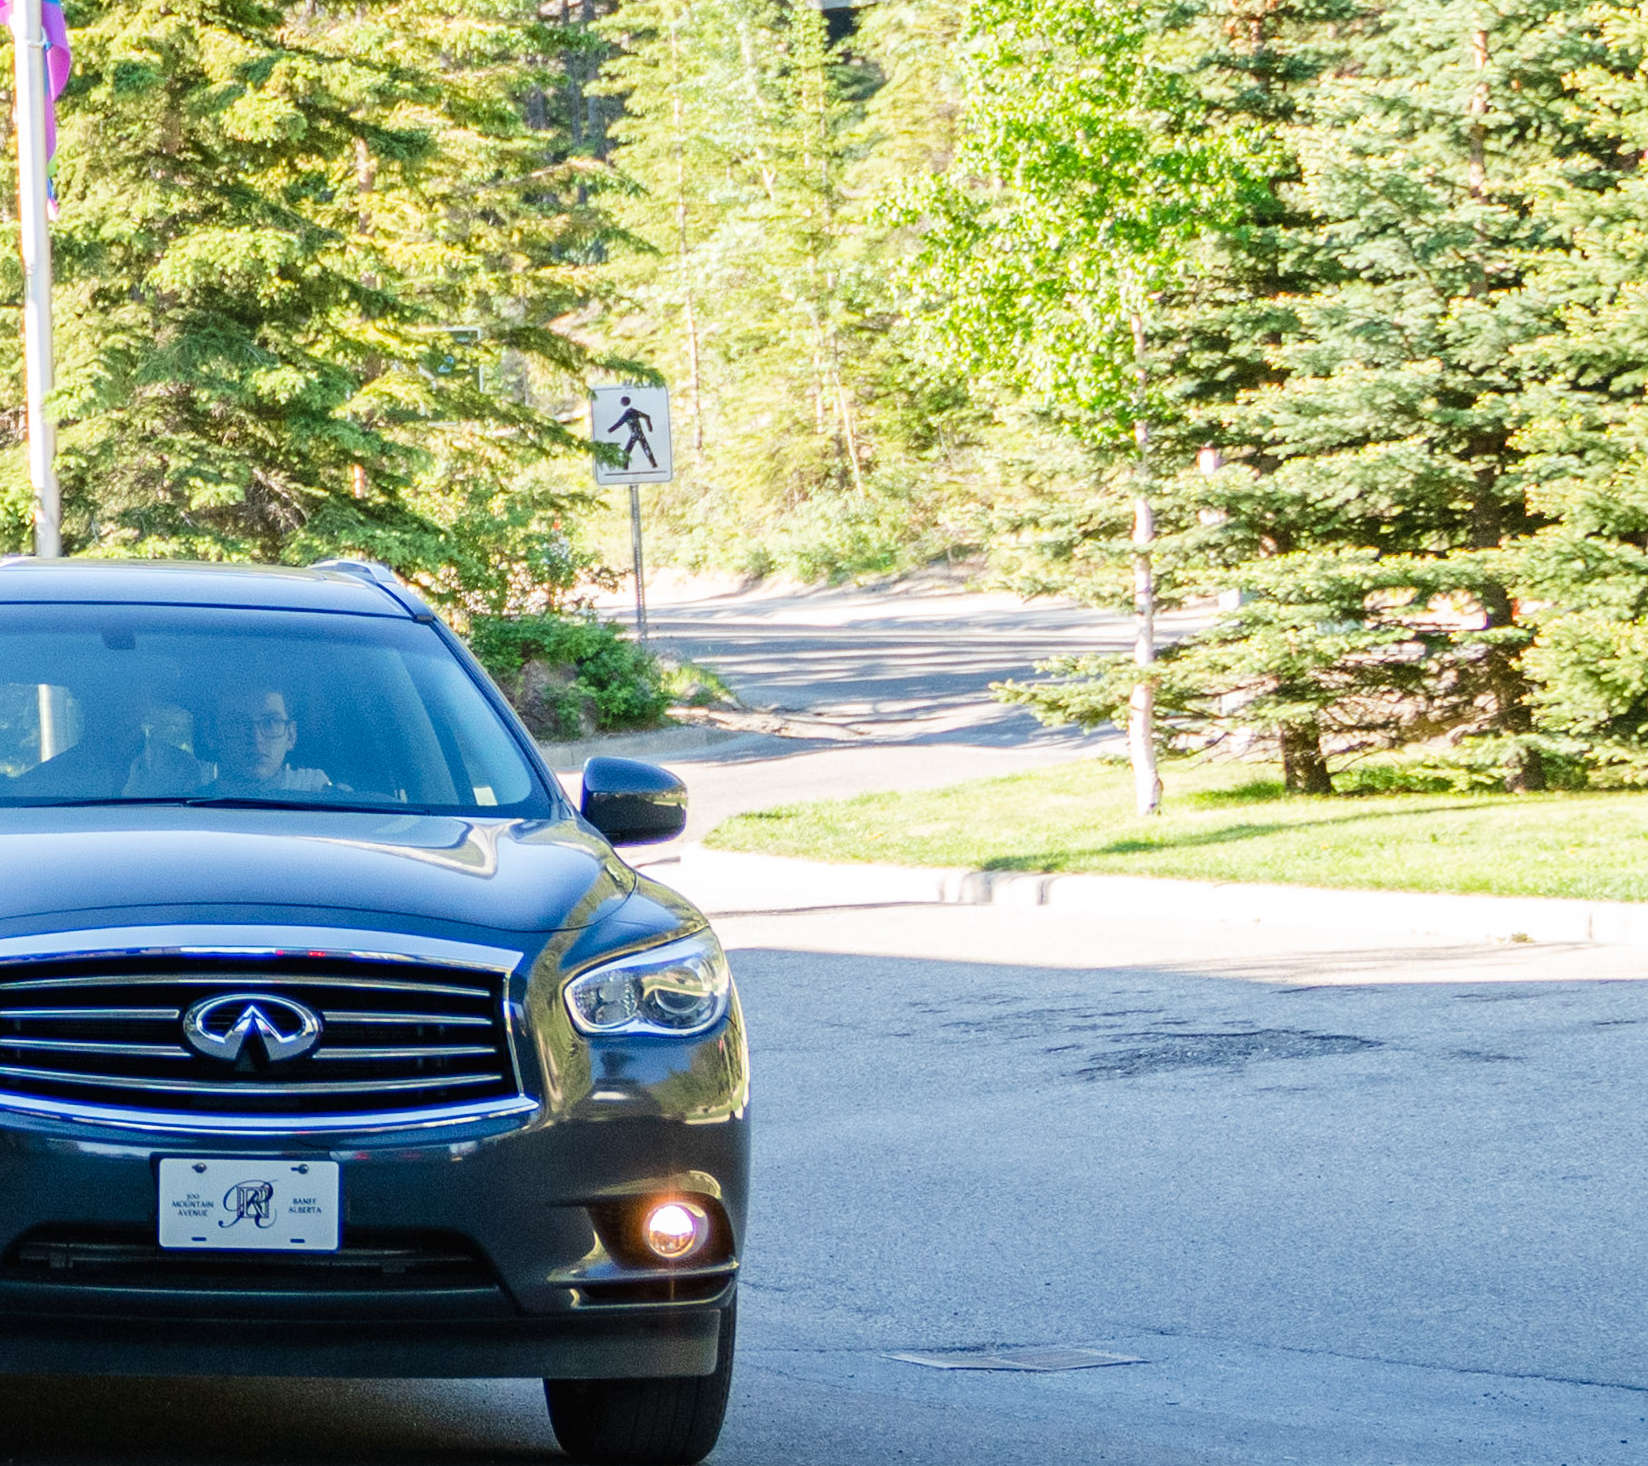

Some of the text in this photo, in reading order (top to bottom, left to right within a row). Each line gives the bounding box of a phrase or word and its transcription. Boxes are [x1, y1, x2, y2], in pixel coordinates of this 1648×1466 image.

[171, 1200, 214, 1208] MOUNTAIN
[292, 1197, 317, 1205] BANFF
[177, 1208, 208, 1217] AVENUE
[288, 1205, 322, 1214] ALBERTA
